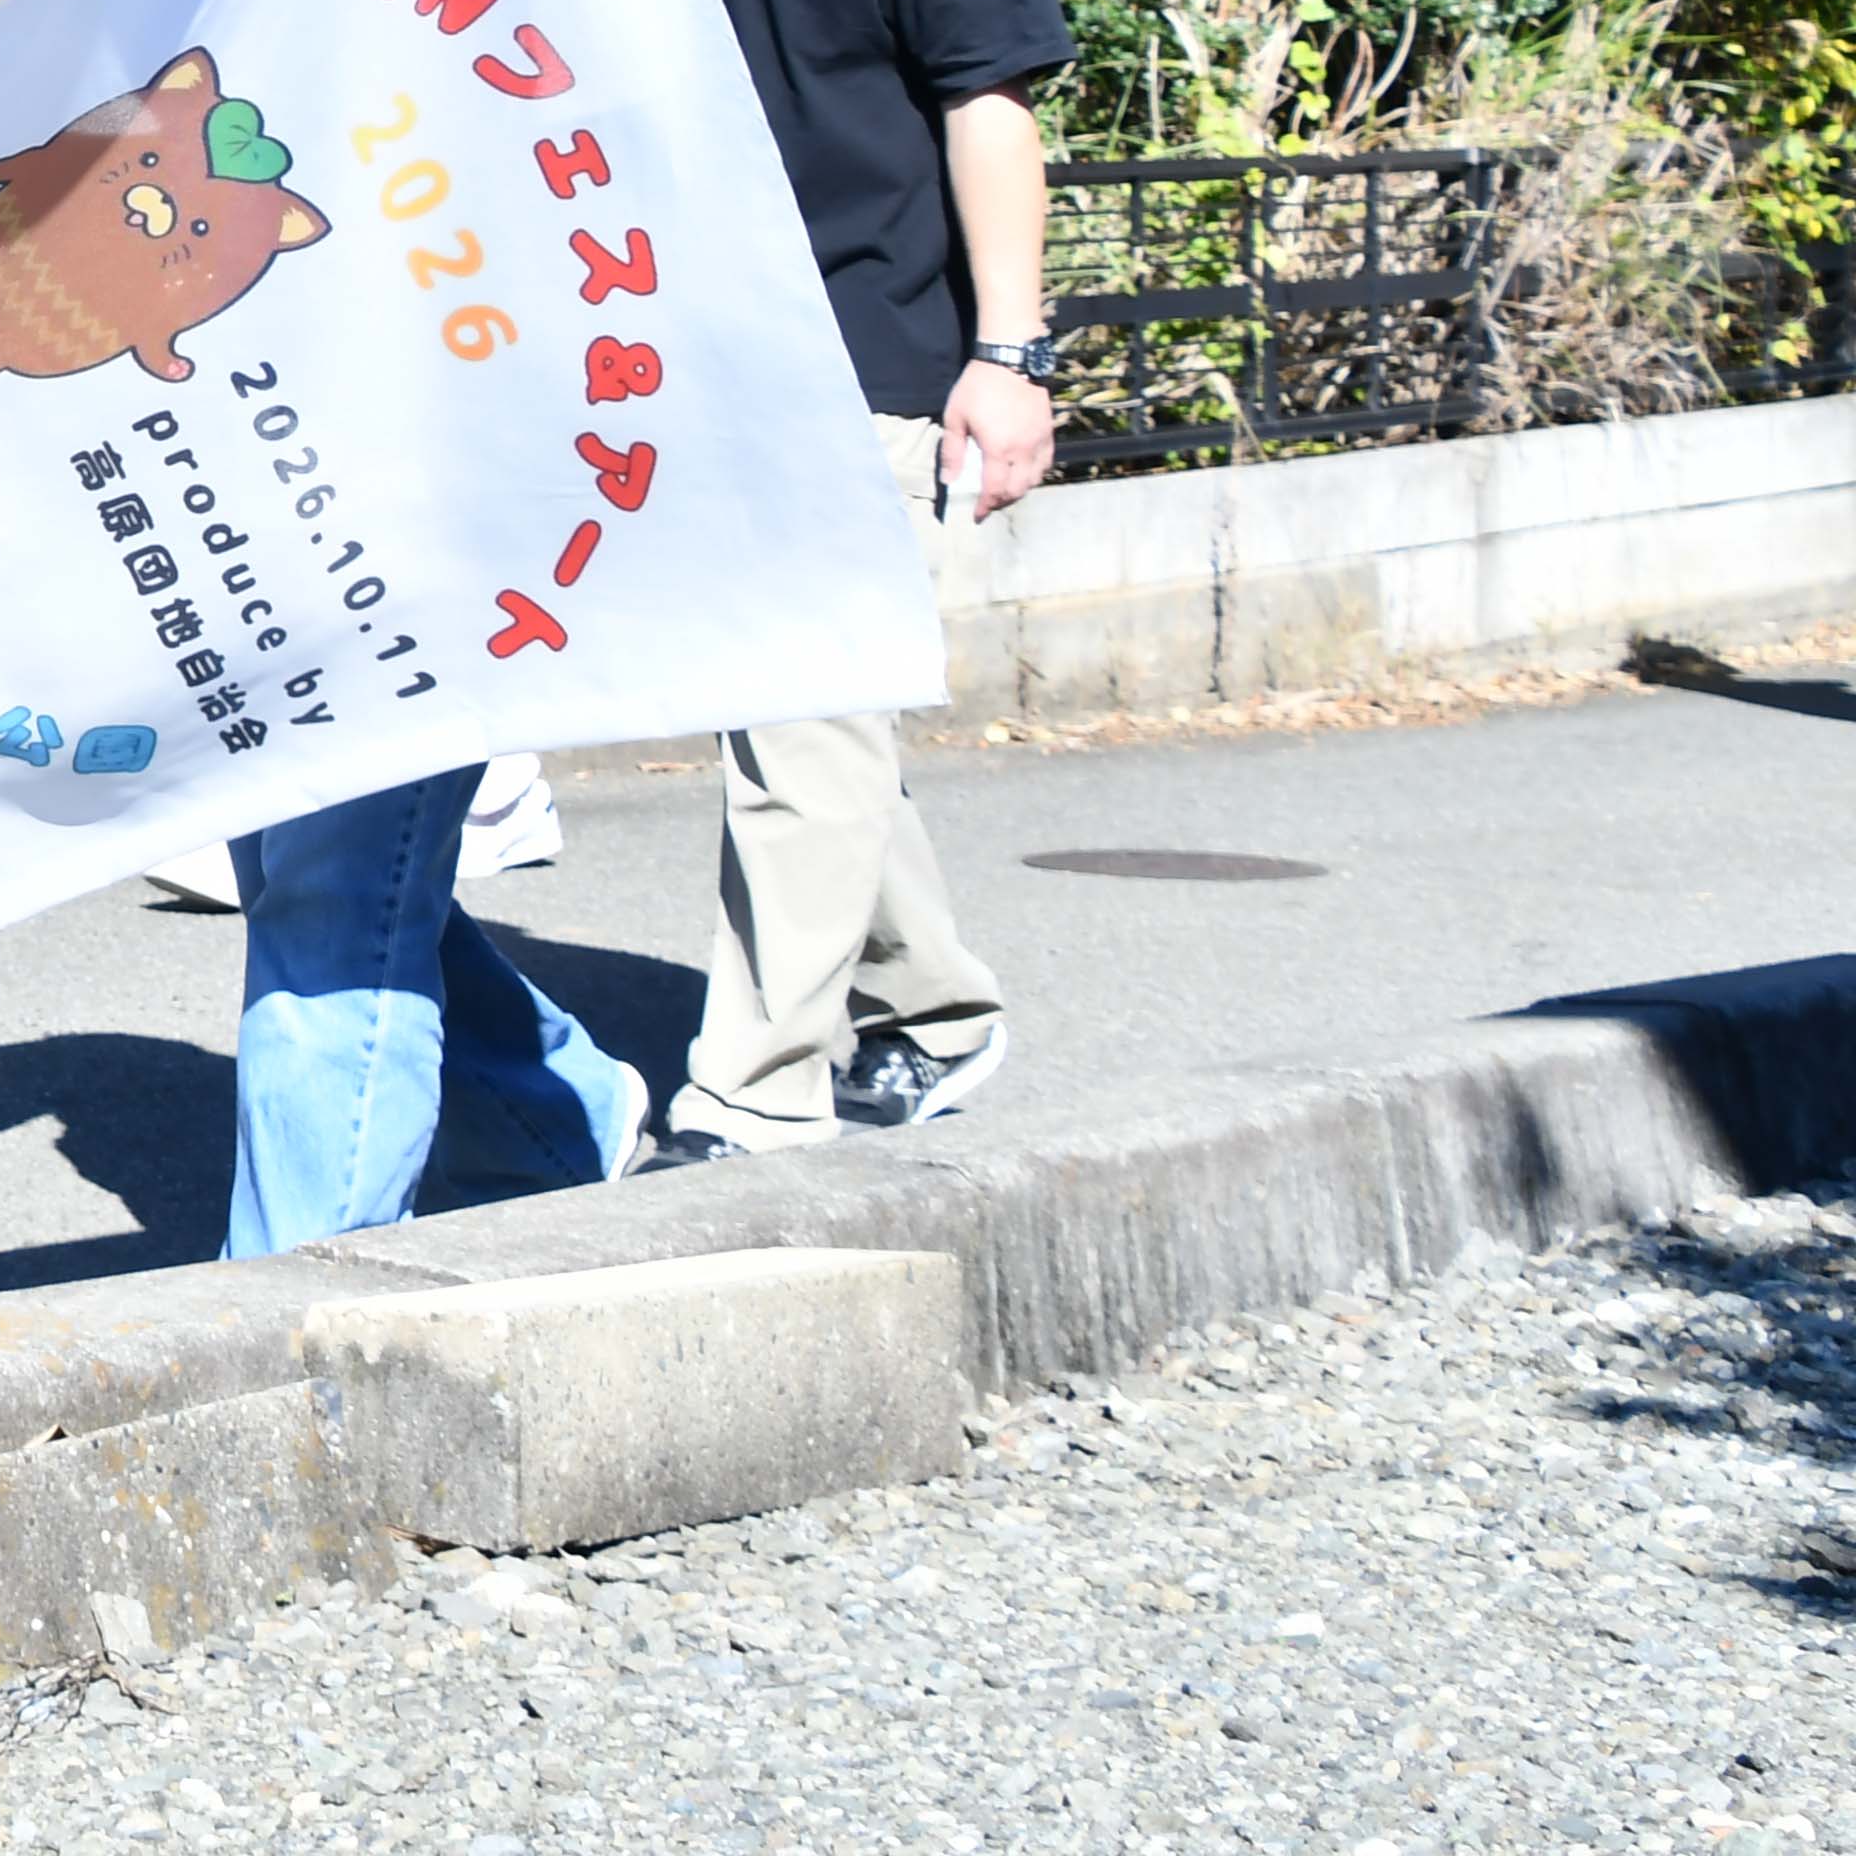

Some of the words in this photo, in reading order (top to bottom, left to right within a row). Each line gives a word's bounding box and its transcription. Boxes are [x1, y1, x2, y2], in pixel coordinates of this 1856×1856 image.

[349, 91, 520, 363] 2026
[69, 440, 269, 755] 高原団地自治会
[130, 409, 288, 652] produce
[283, 667, 336, 726] by
[229, 360, 438, 699] 2026.10.11
